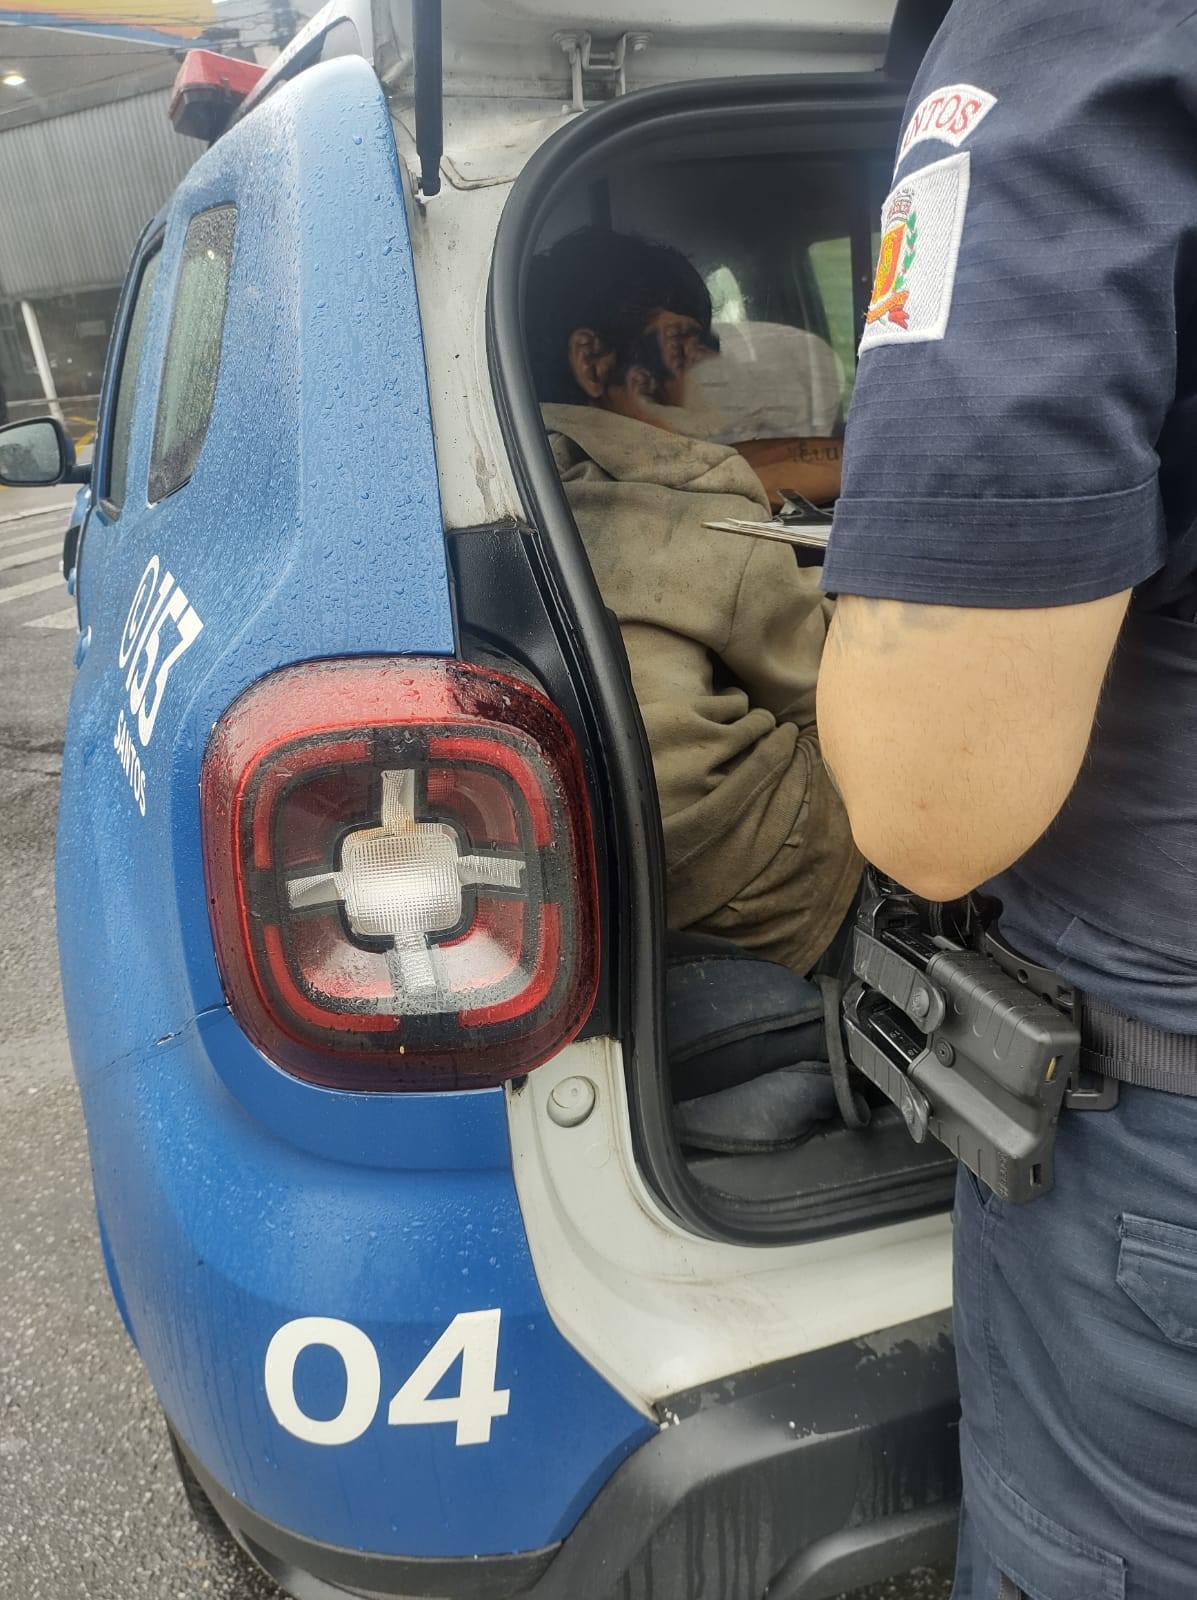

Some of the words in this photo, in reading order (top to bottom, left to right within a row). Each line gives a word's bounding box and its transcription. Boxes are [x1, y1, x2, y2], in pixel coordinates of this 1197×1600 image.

[903, 94, 982, 149] NTOS
[113, 709, 146, 817] SANTOS
[264, 1308, 511, 1446] 04
